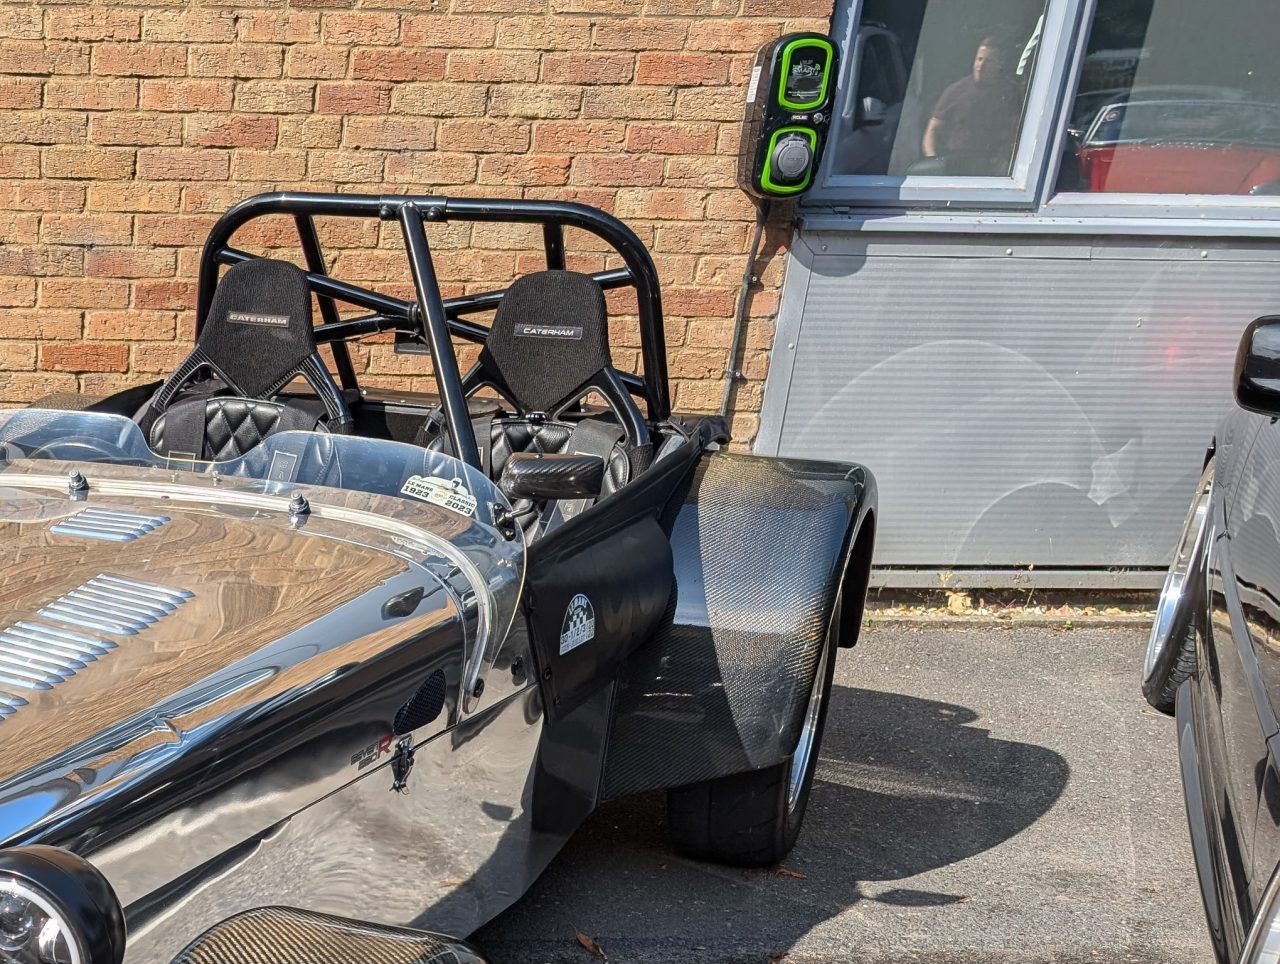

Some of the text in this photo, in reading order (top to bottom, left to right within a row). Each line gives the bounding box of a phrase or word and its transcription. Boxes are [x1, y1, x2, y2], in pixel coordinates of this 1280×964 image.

[229, 314, 287, 324] CATERHAM
[523, 327, 574, 336] CATERHAM
[403, 485, 430, 498] 1923
[415, 483, 434, 492] MANS
[449, 494, 476, 508] CLASSIC
[445, 500, 473, 515] 2023
